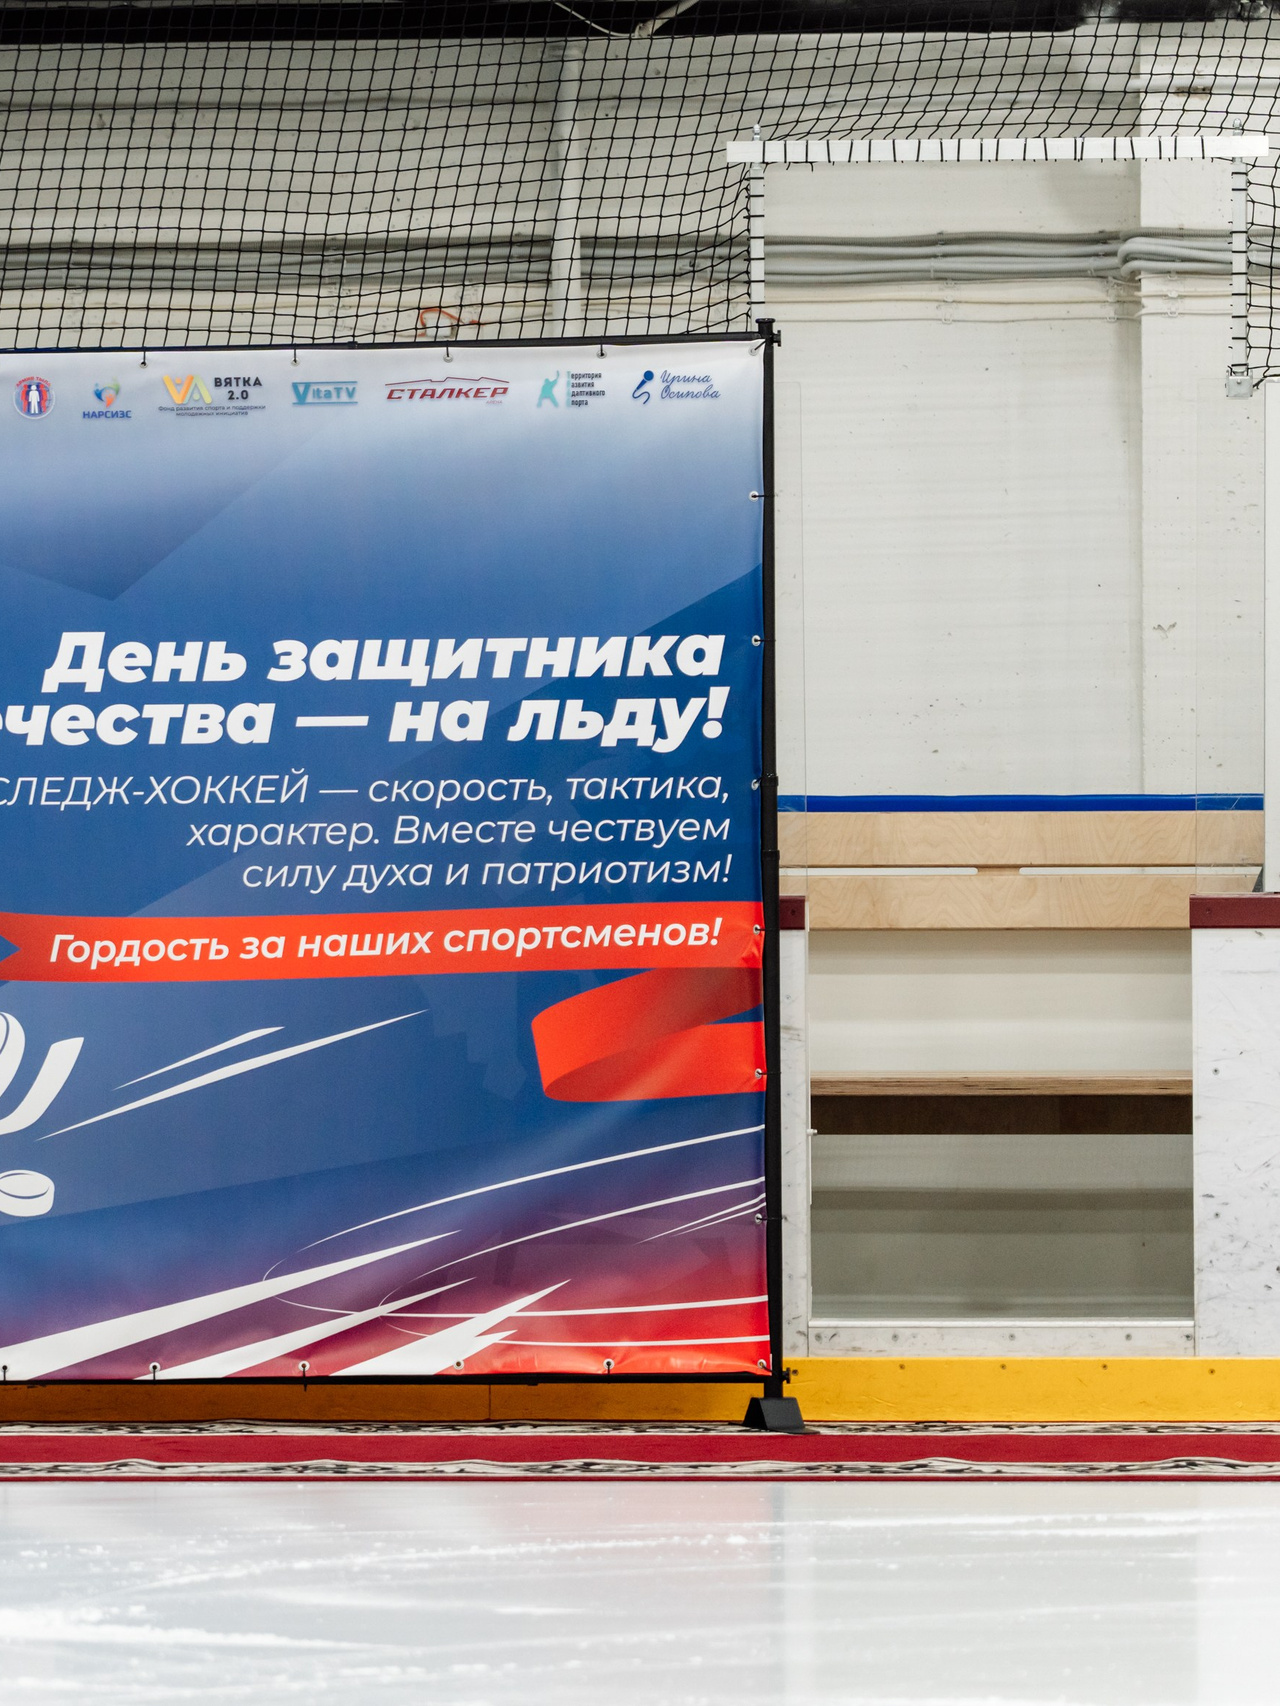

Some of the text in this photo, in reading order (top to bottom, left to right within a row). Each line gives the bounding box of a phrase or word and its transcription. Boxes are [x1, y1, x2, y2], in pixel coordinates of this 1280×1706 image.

[214, 376, 263, 387] ВЯТКА
[660, 370, 713, 384] Ирина
[227, 390, 249, 400] 2.0
[386, 387, 510, 401] СТАЛКЕР
[660, 384, 722, 400] Осипова
[82, 410, 132, 419] НАРСИЗС
[42, 632, 725, 692] День защитника
[389, 701, 489, 741] на
[508, 687, 730, 752] льду!
[369, 779, 553, 809] скорость,
[566, 777, 729, 804] тактика,
[187, 816, 730, 852] характер. Вместе чествуем
[243, 854, 733, 894] силу духа и патриотизм!
[51, 918, 723, 970] Гордость за наших спортсменов!
